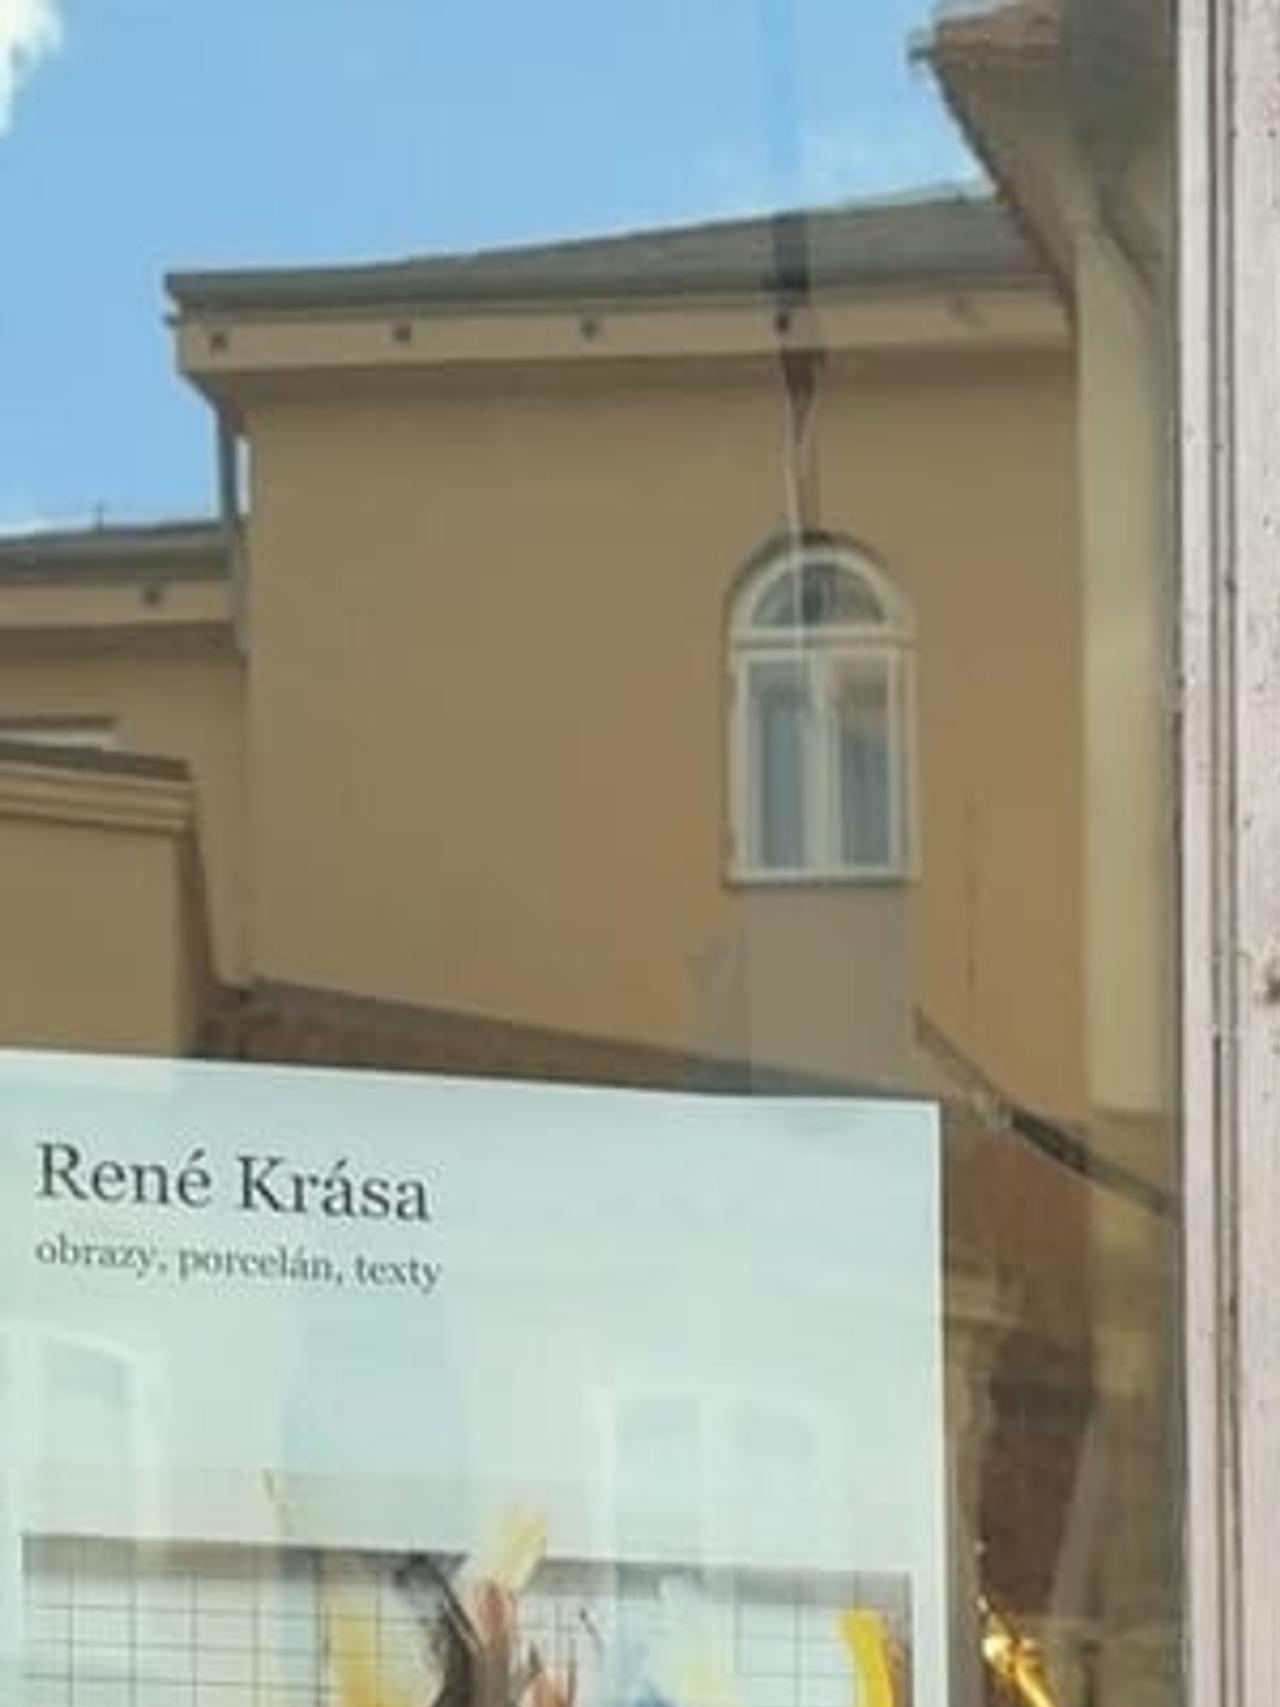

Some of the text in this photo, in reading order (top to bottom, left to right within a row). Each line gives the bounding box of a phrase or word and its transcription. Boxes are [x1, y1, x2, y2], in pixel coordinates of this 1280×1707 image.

[36, 1141, 432, 1221] René Krása
[34, 1232, 443, 1295] obrazy, porcelán, texty
